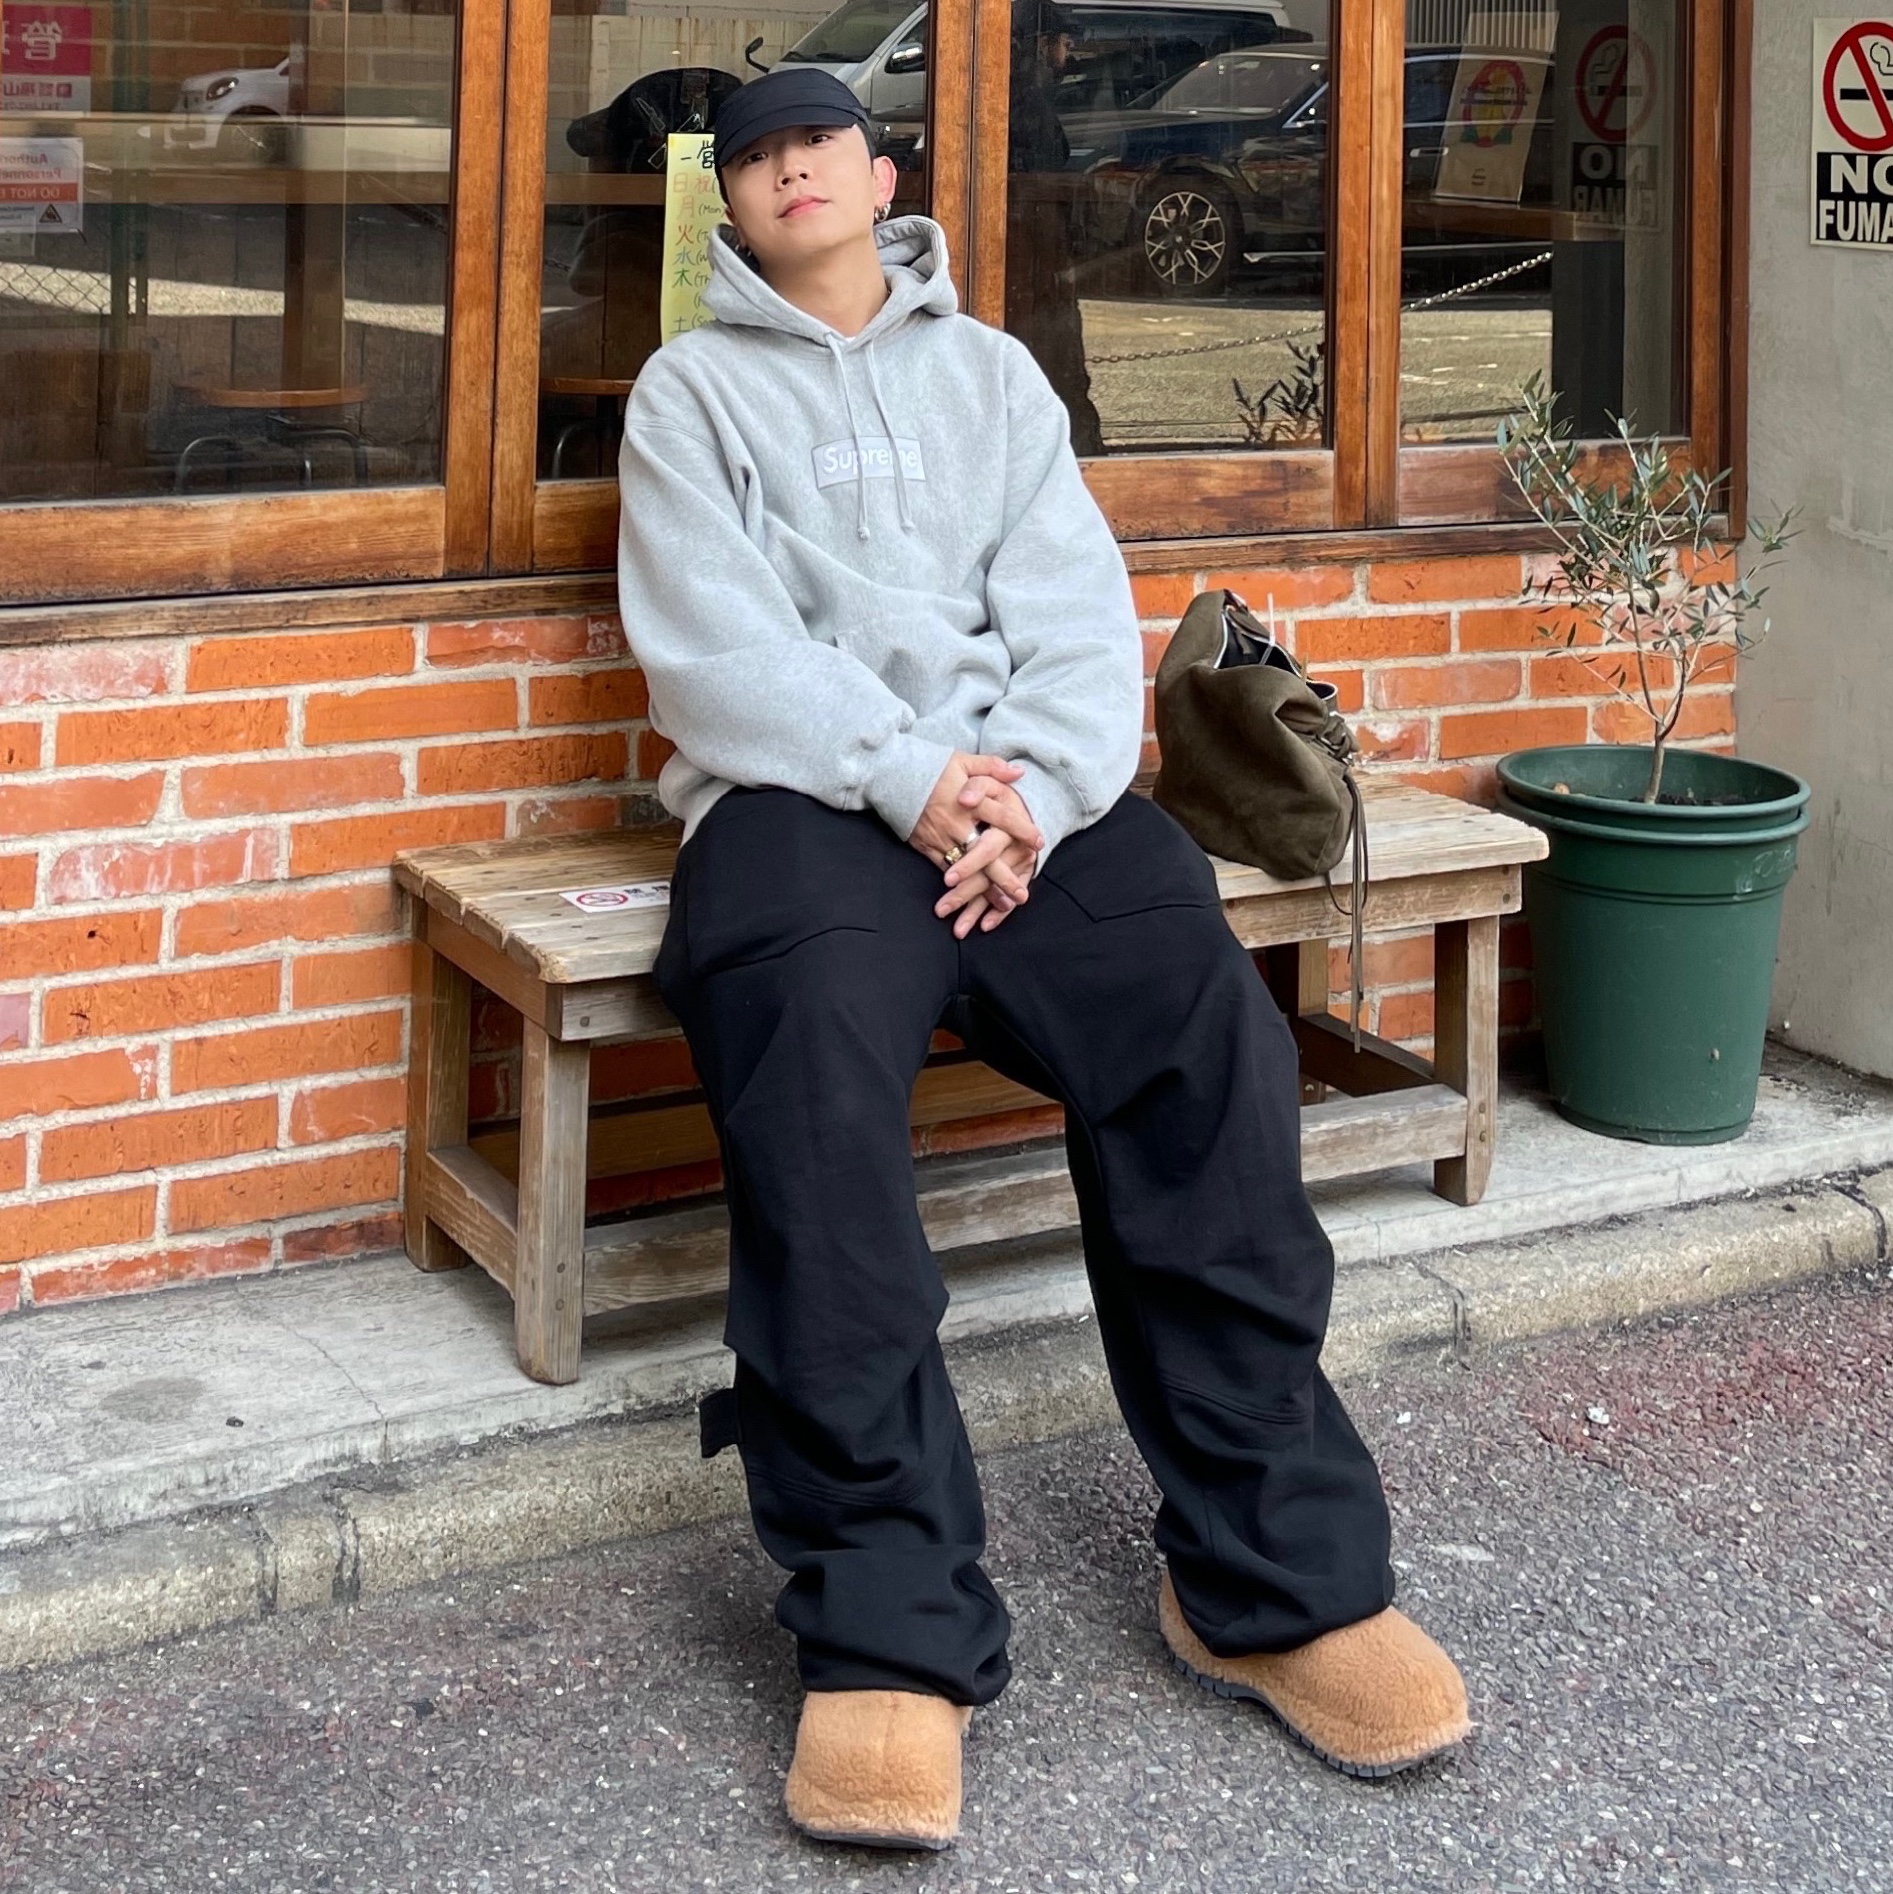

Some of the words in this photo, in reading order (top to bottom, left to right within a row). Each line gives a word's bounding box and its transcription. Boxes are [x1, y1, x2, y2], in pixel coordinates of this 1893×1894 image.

[675, 225, 694, 246] 火
[672, 246, 696, 266] 水
[671, 268, 693, 289] 木
